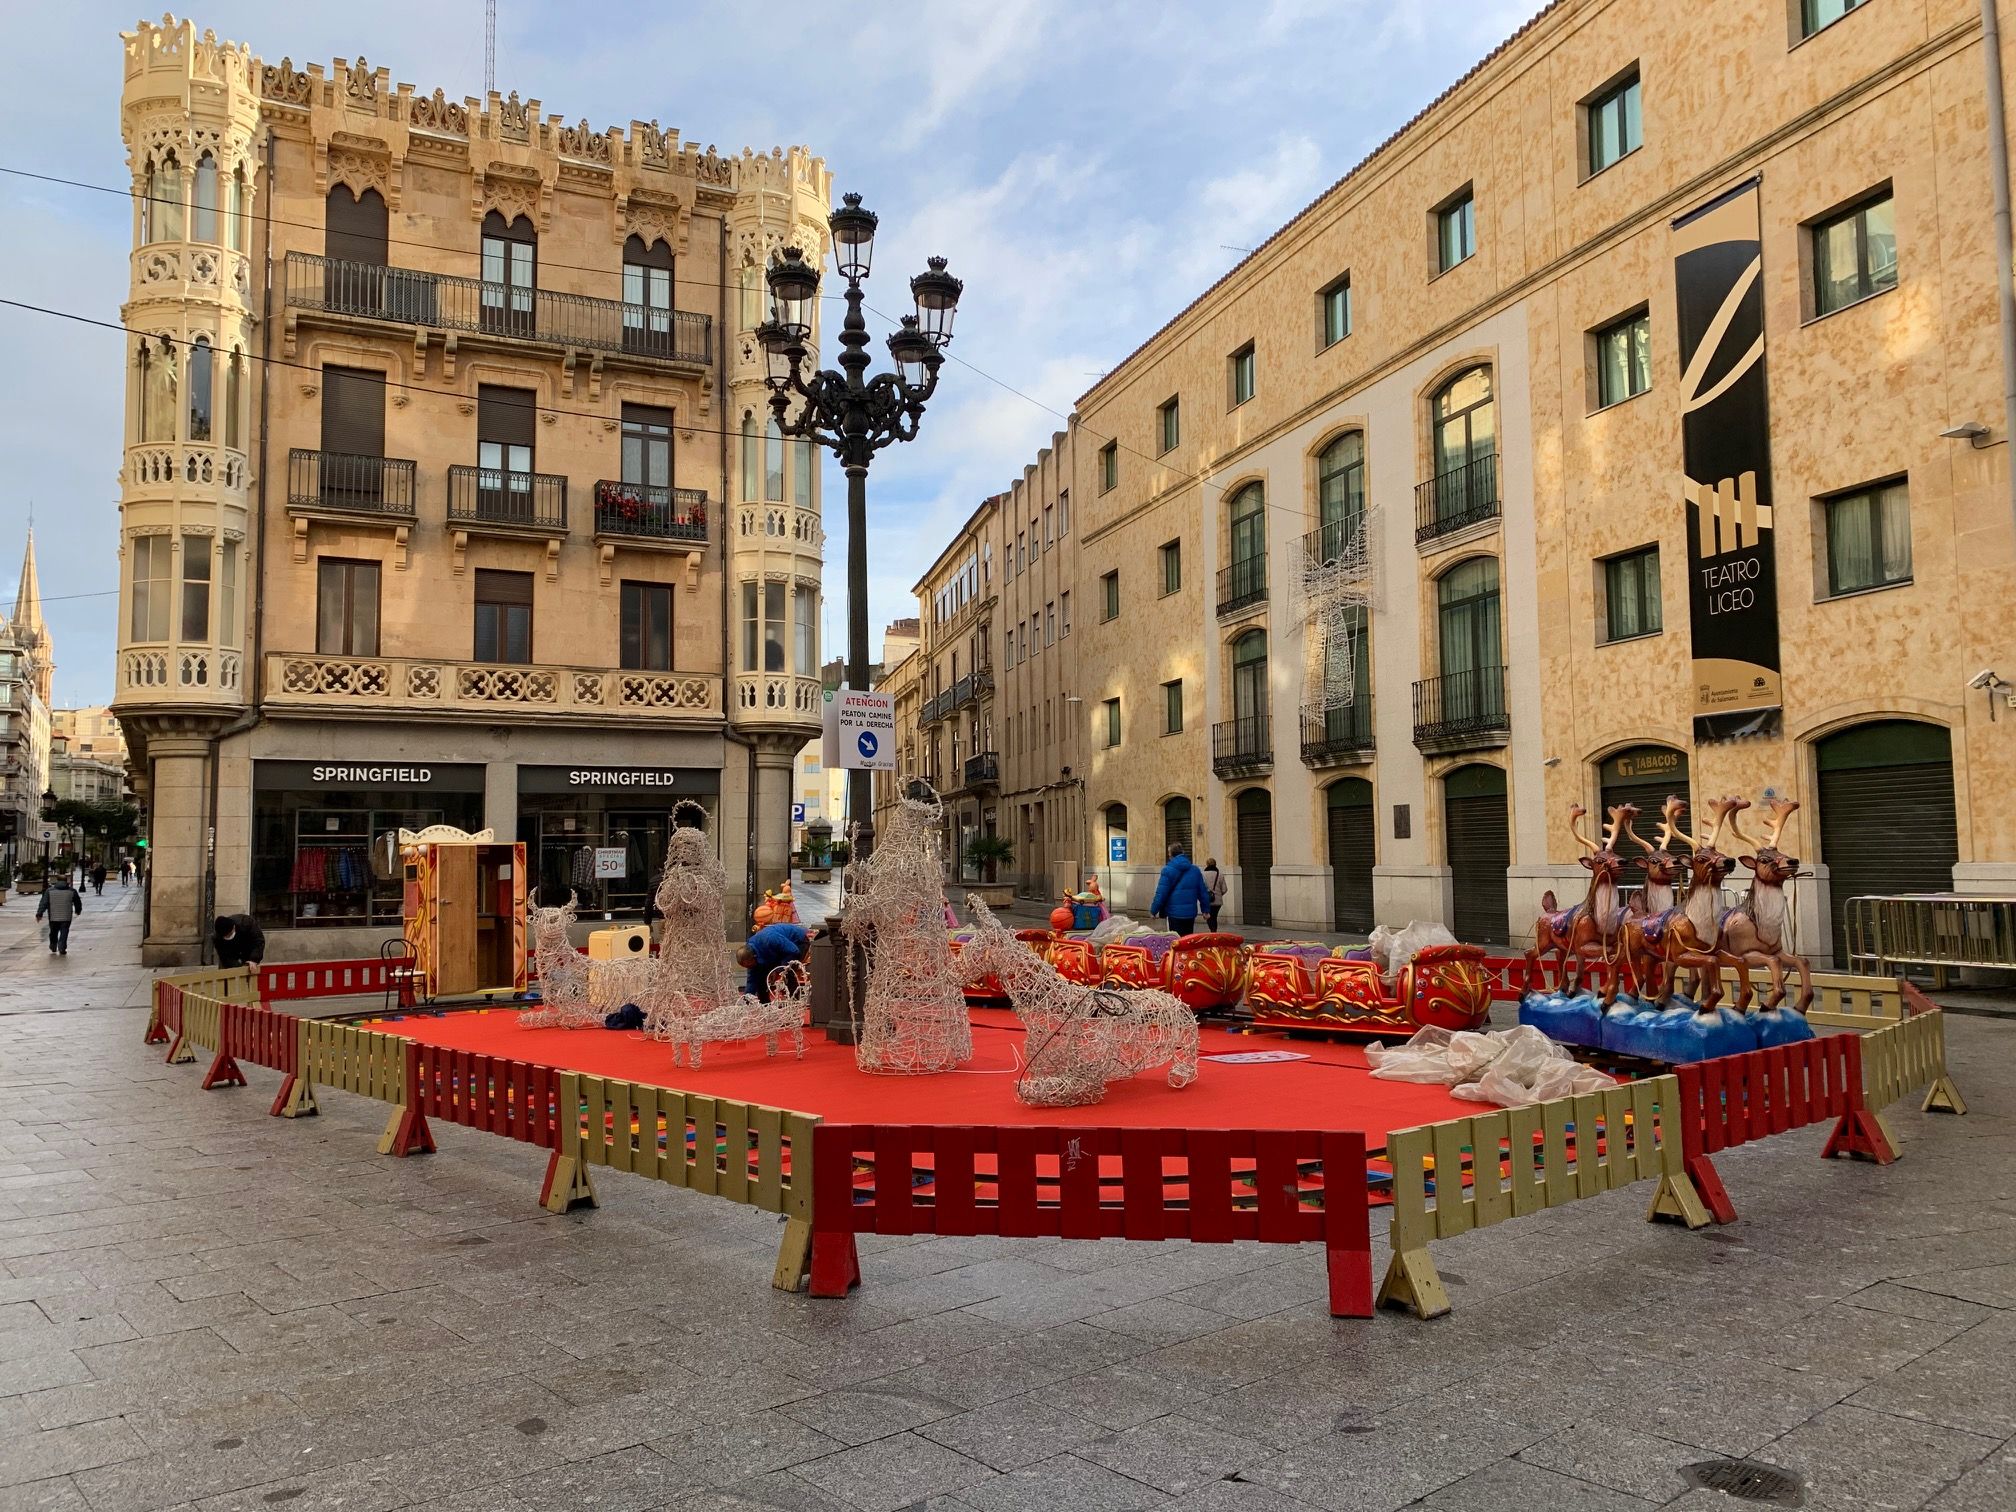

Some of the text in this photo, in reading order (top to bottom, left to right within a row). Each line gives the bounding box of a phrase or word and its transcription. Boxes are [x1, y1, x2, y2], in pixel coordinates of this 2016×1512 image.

[1701, 558, 1760, 589] TEATRO
[1709, 587, 1755, 615] LICEO
[869, 711, 892, 720] CAMINE
[840, 719, 853, 727] POR
[866, 721, 894, 729] DERECHA
[1636, 754, 1678, 769] TABACOS
[312, 767, 432, 782] SPRINGFIELD
[569, 771, 674, 786] SPRINGFIELD
[792, 805, 802, 820] P
